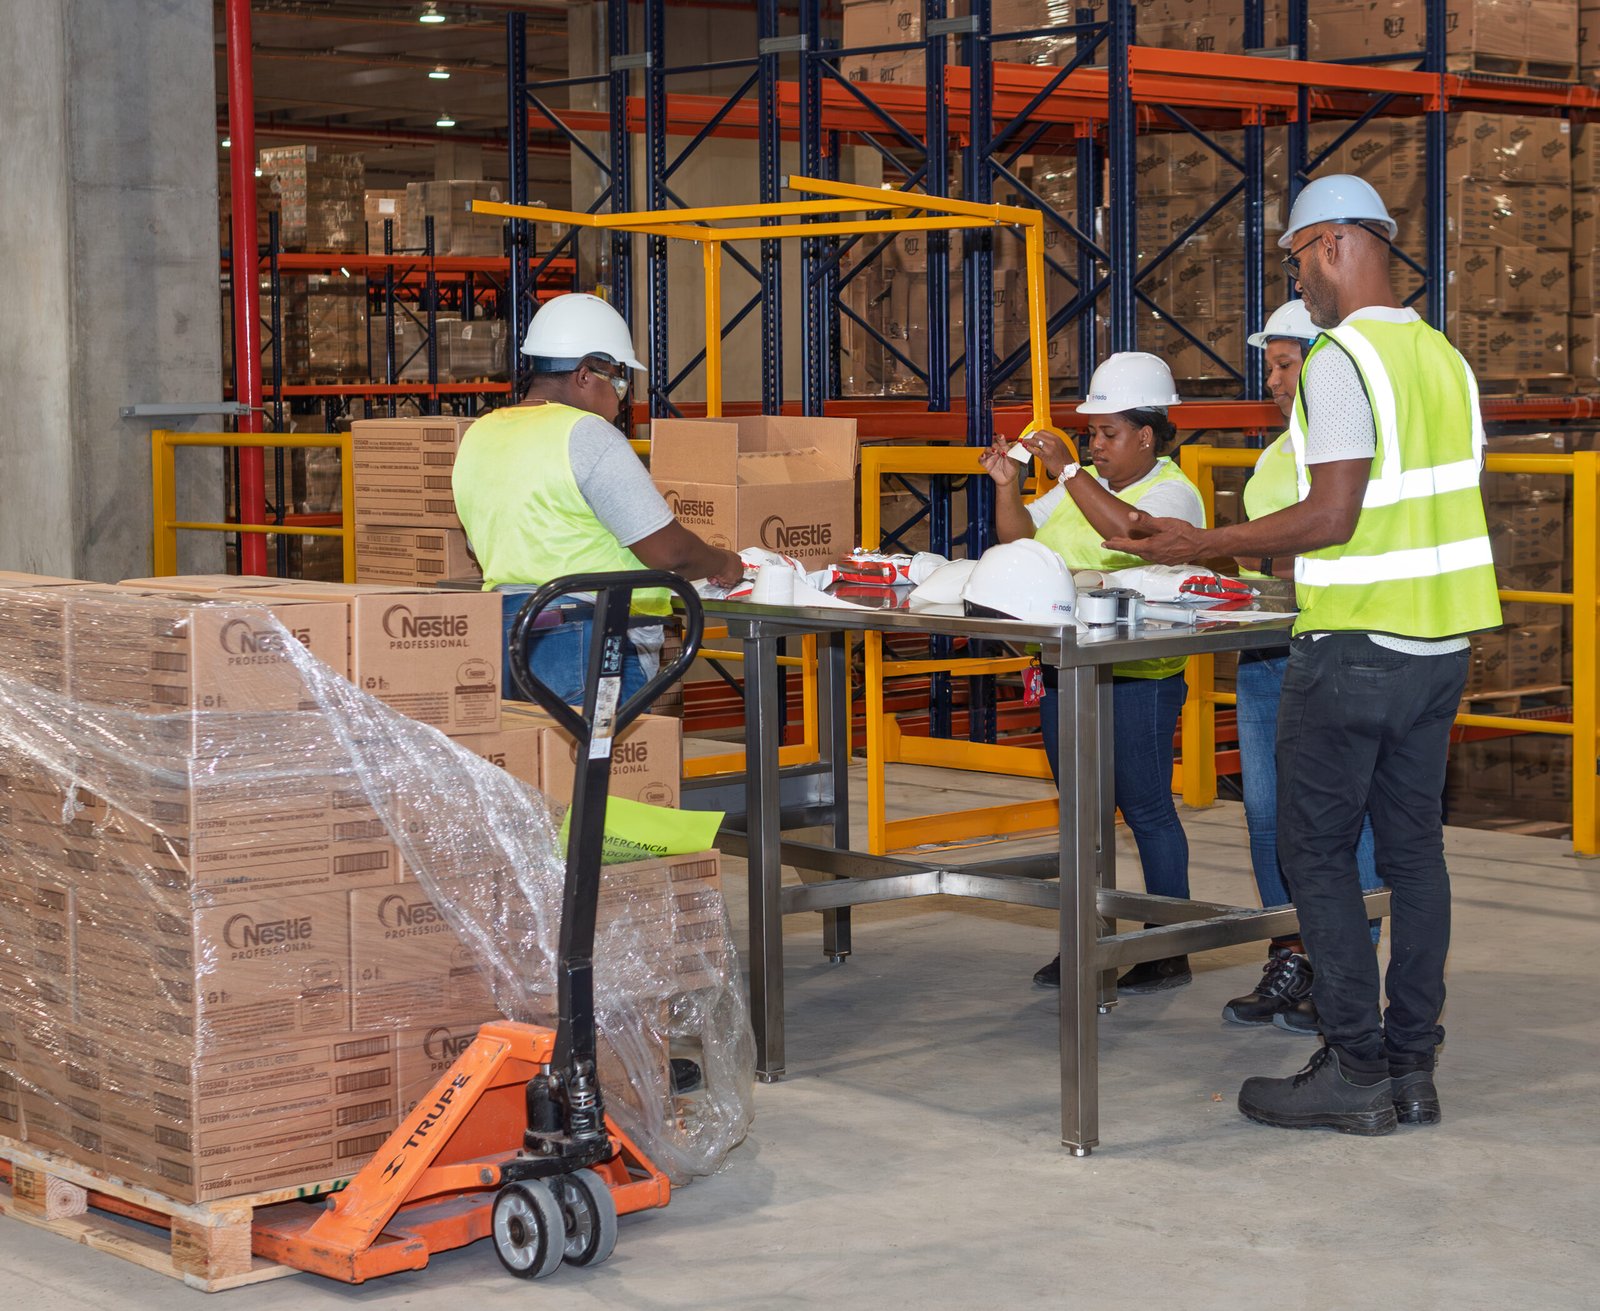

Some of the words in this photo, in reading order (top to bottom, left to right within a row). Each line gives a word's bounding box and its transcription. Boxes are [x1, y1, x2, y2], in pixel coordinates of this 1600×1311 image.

[672, 498, 715, 517] Nestlé
[773, 521, 832, 549] Nestlé
[398, 611, 469, 639] Nestlé
[389, 638, 470, 650] PROFESSIONAL
[602, 835, 668, 853] MERCANCIA
[239, 915, 313, 948] Nestlé
[231, 941, 314, 962] PROFESSIONAL
